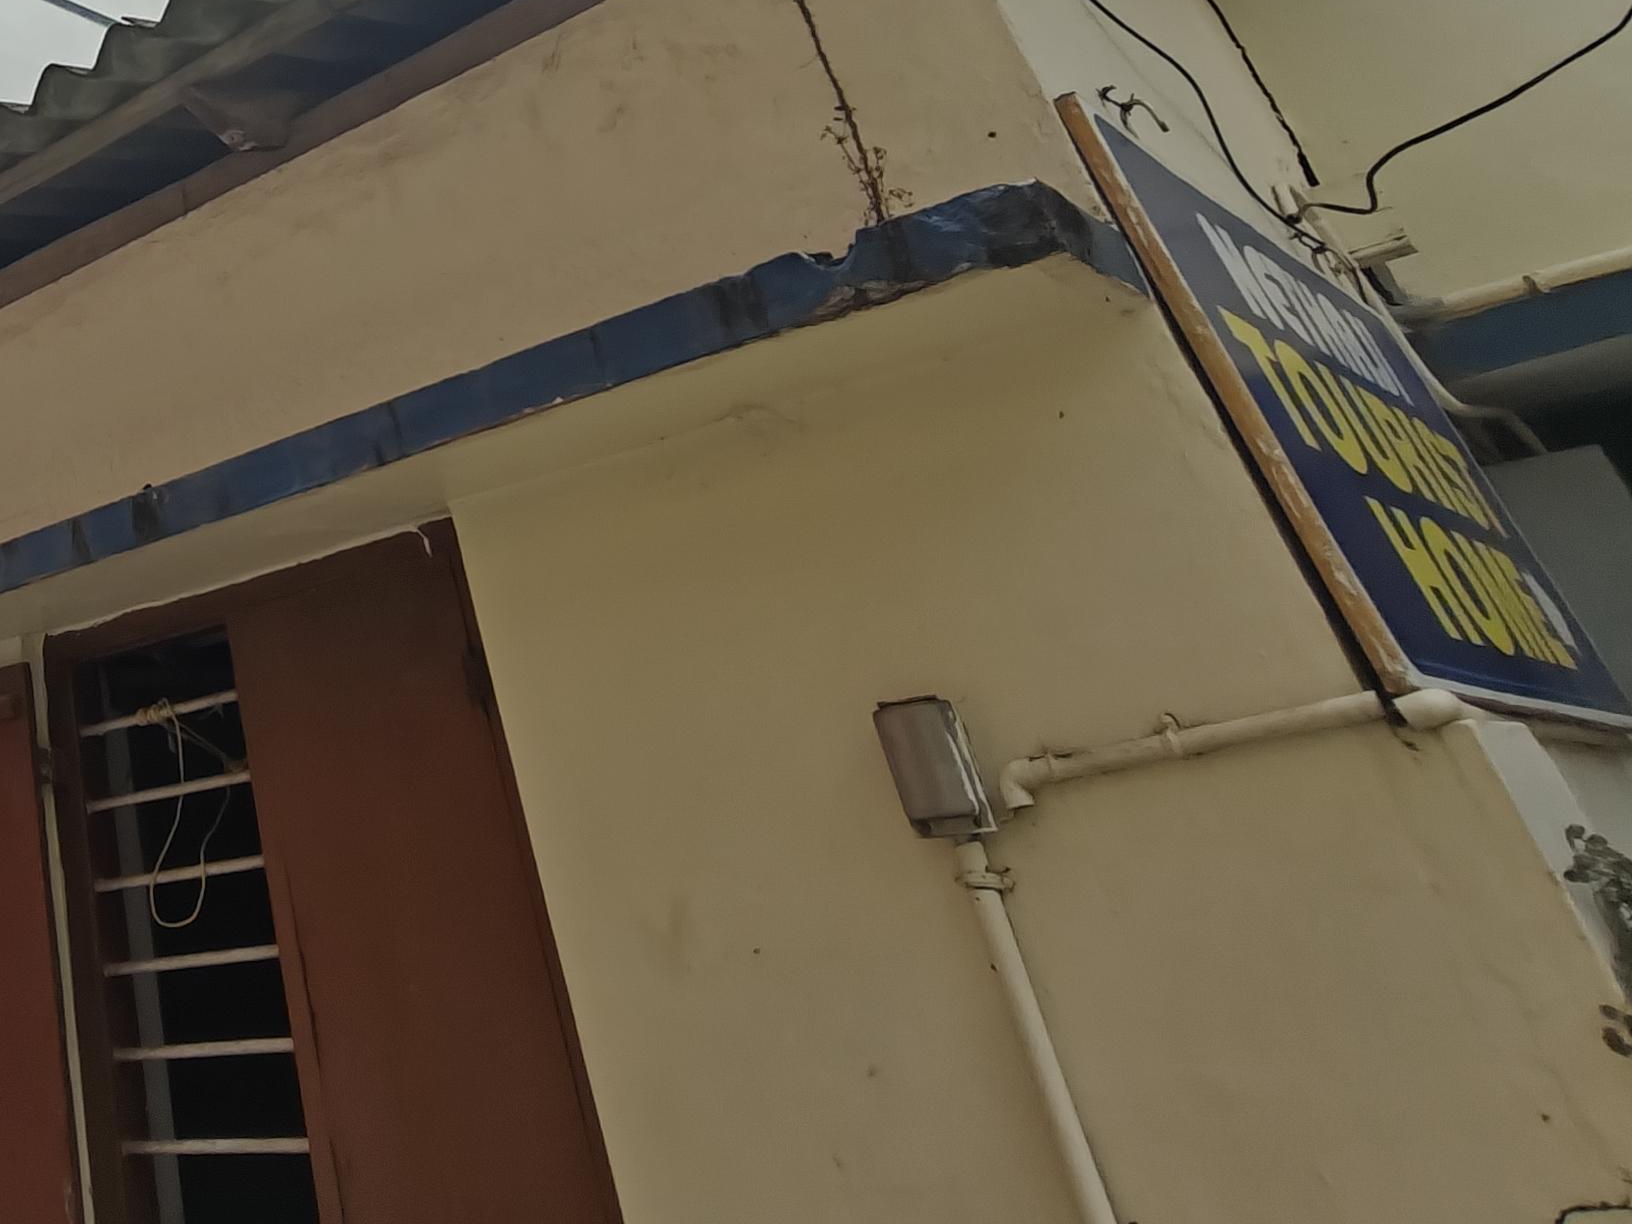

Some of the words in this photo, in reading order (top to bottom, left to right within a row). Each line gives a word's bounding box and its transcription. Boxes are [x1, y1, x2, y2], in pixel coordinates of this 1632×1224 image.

[1196, 212, 1415, 407] NETHAJI
[1217, 305, 1509, 539] TOURIST
[1364, 495, 1578, 671] HOME
